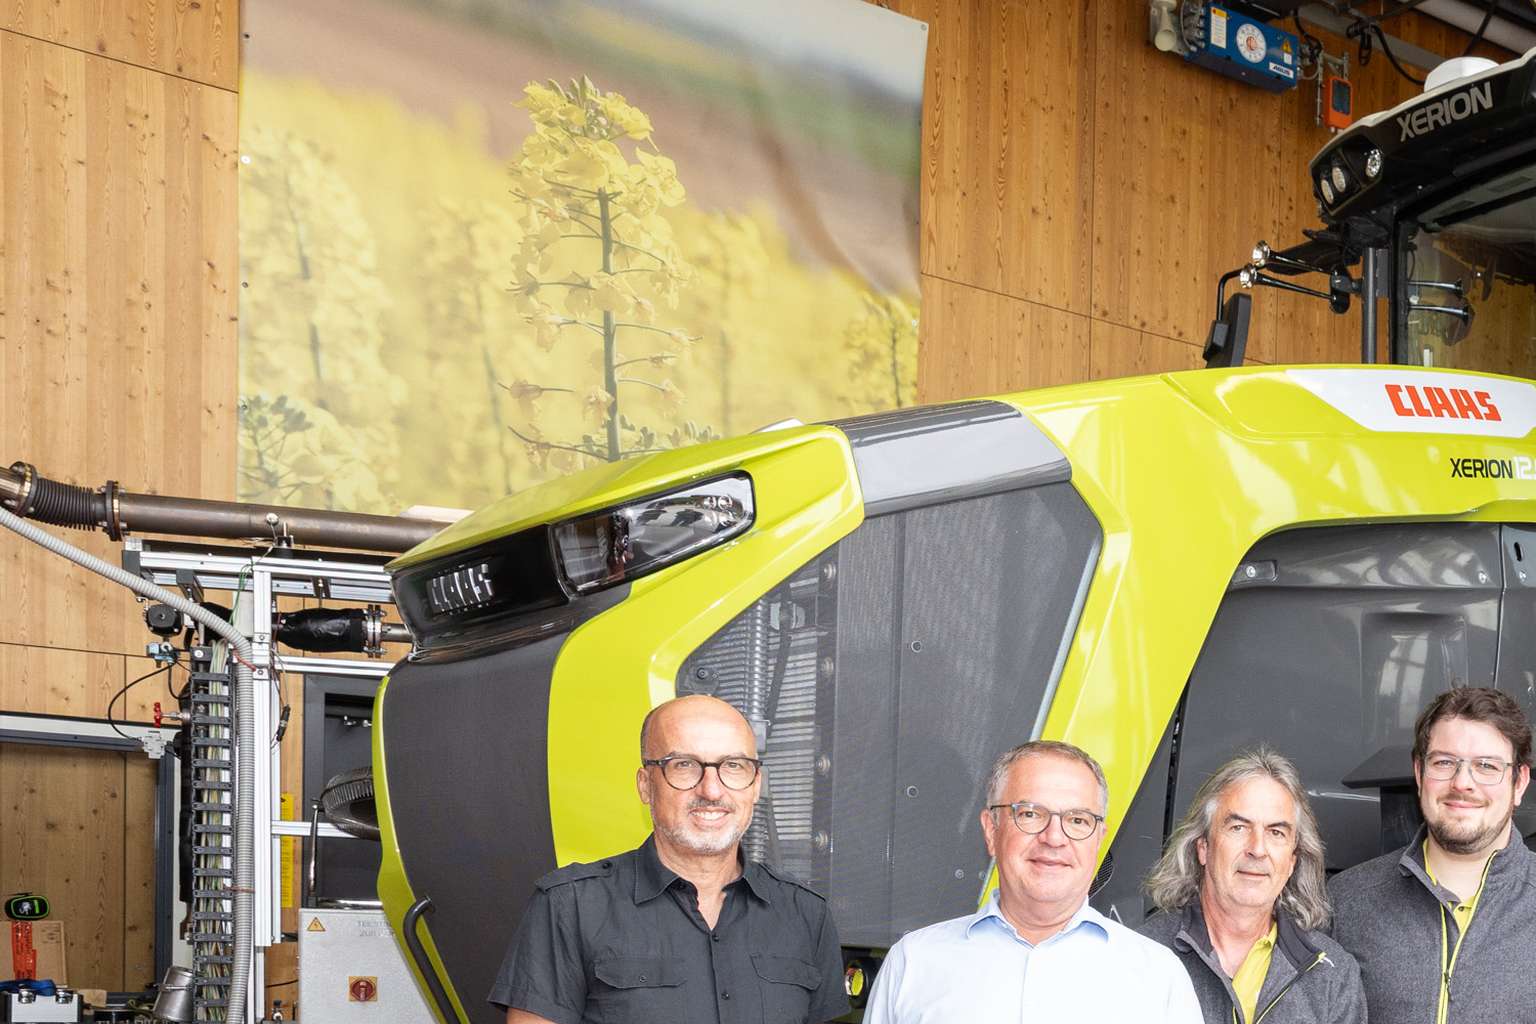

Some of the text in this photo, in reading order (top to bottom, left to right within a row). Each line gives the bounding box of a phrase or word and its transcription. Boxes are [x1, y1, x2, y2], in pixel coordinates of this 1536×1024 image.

[1396, 81, 1494, 142] XERION
[1384, 384, 1502, 422] CLAAS
[1450, 457, 1513, 479] XERION
